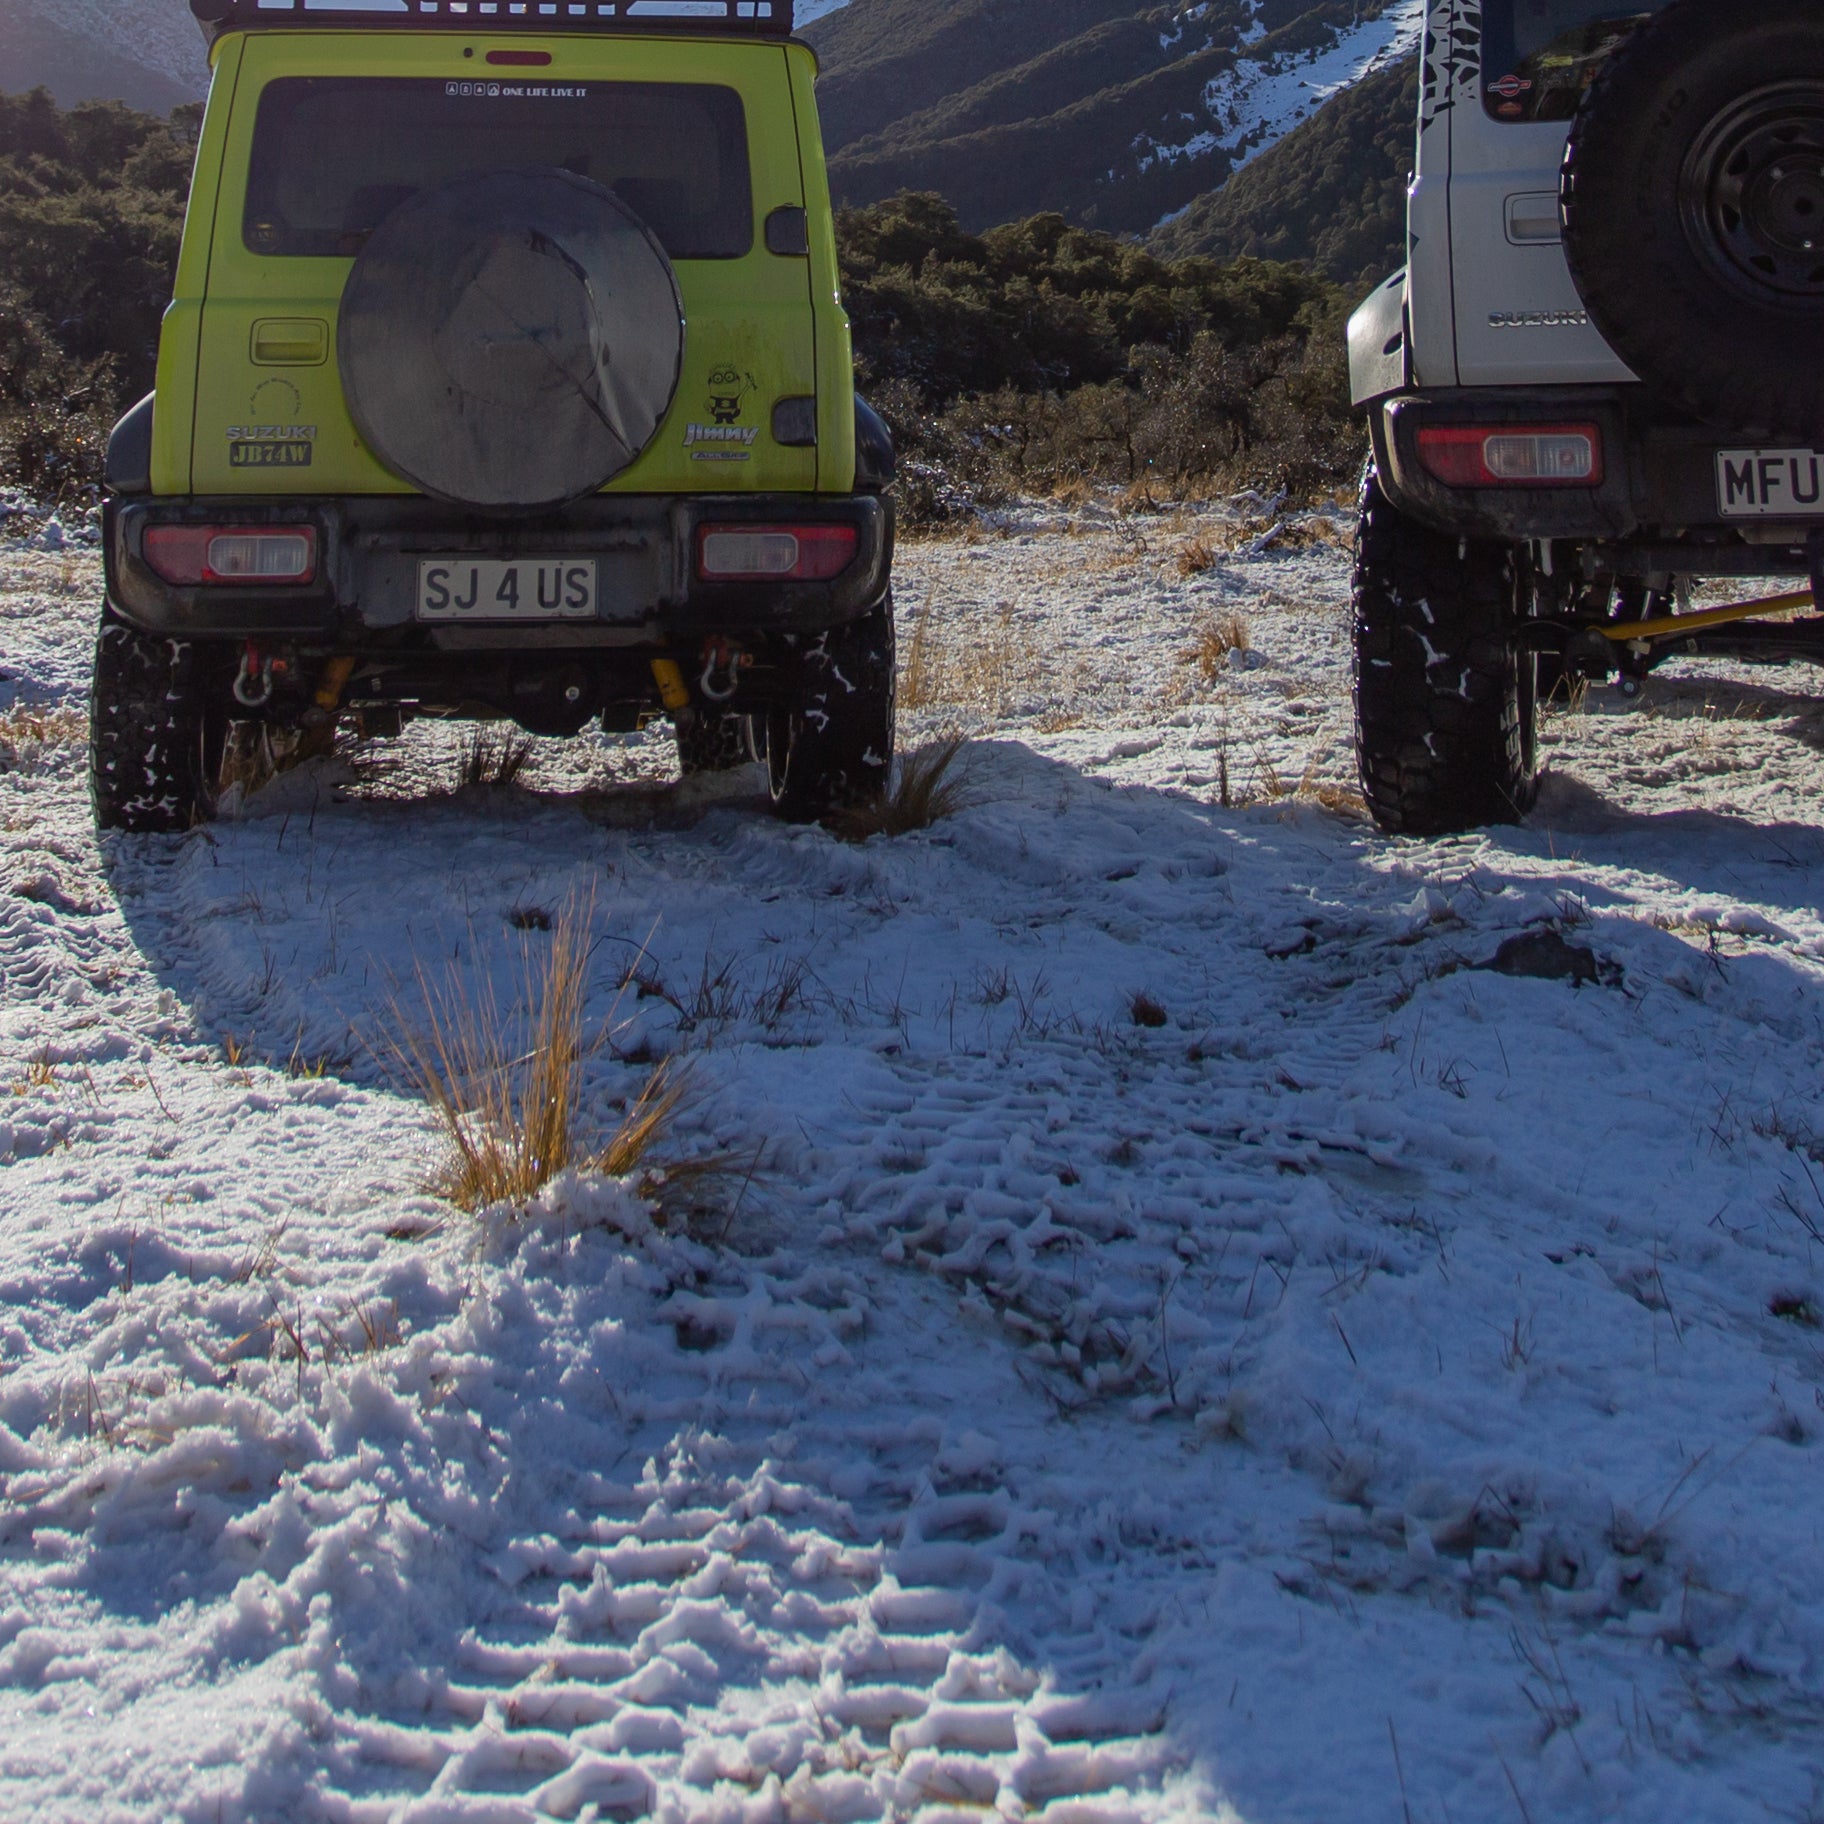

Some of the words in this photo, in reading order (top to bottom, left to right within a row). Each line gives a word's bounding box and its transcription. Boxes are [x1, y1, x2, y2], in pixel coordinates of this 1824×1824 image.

[502, 87, 525, 97] ONE
[527, 87, 549, 97] LIFE
[551, 87, 574, 97] LIVE
[576, 88, 587, 97] IT
[1488, 309, 1587, 328] SUZUKI
[226, 425, 318, 441] SUZUKI
[233, 445, 308, 464] JB74W
[425, 568, 479, 610] SJ
[495, 567, 520, 609] 4
[537, 567, 589, 609] US
